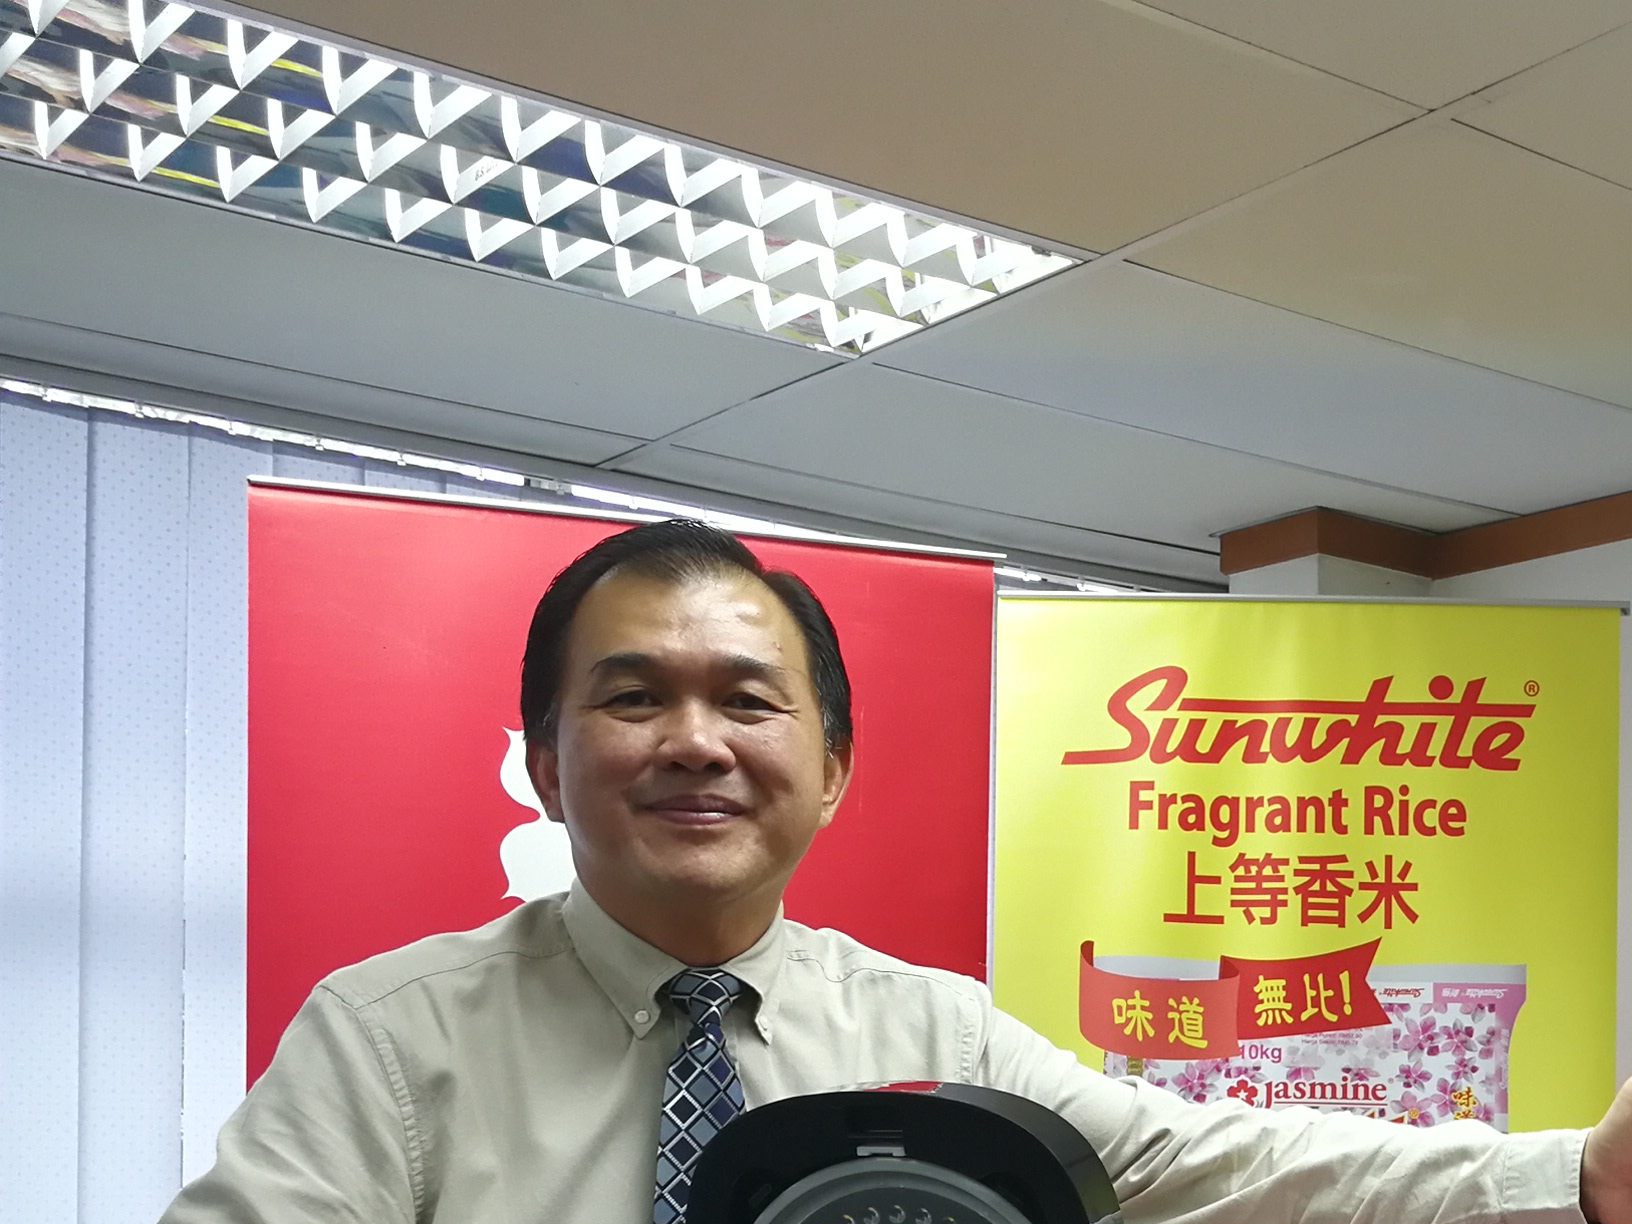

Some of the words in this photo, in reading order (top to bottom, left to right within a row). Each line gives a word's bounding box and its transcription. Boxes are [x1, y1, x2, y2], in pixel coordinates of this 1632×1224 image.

[1061, 665, 1536, 771] Sunwhite
[1128, 781, 1348, 847] Fragrant
[1364, 785, 1466, 837] Rice
[1163, 851, 1419, 930] 上等香米
[1112, 990, 1208, 1049] 味道
[1254, 971, 1352, 1027] 無比!
[1264, 1076, 1388, 1109] Jasmine
